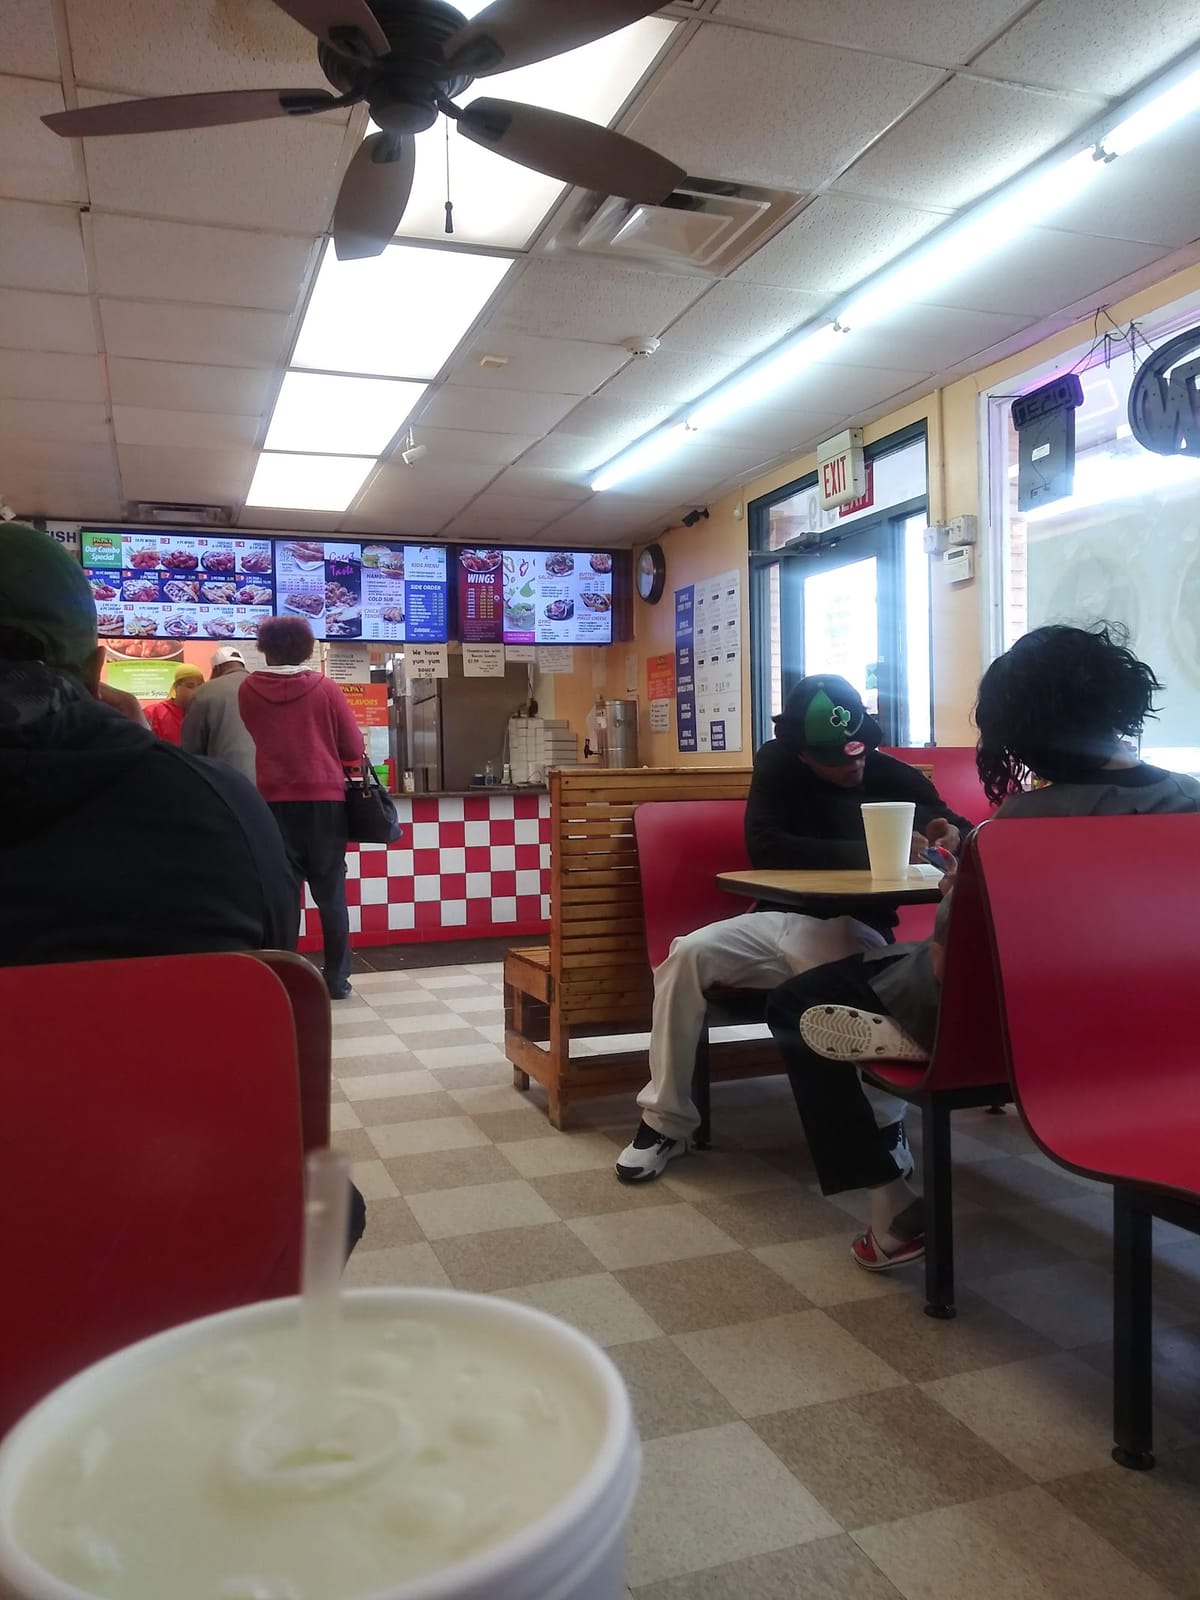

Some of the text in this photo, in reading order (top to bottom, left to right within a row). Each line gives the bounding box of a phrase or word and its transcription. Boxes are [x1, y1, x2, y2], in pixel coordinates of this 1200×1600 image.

[823, 455, 846, 499] EXIT
[85, 545, 121, 554] Our Combo
[91, 553, 115, 562] Special
[329, 551, 354, 564] Great
[330, 564, 354, 576] Taste
[467, 574, 495, 584] WINGS
